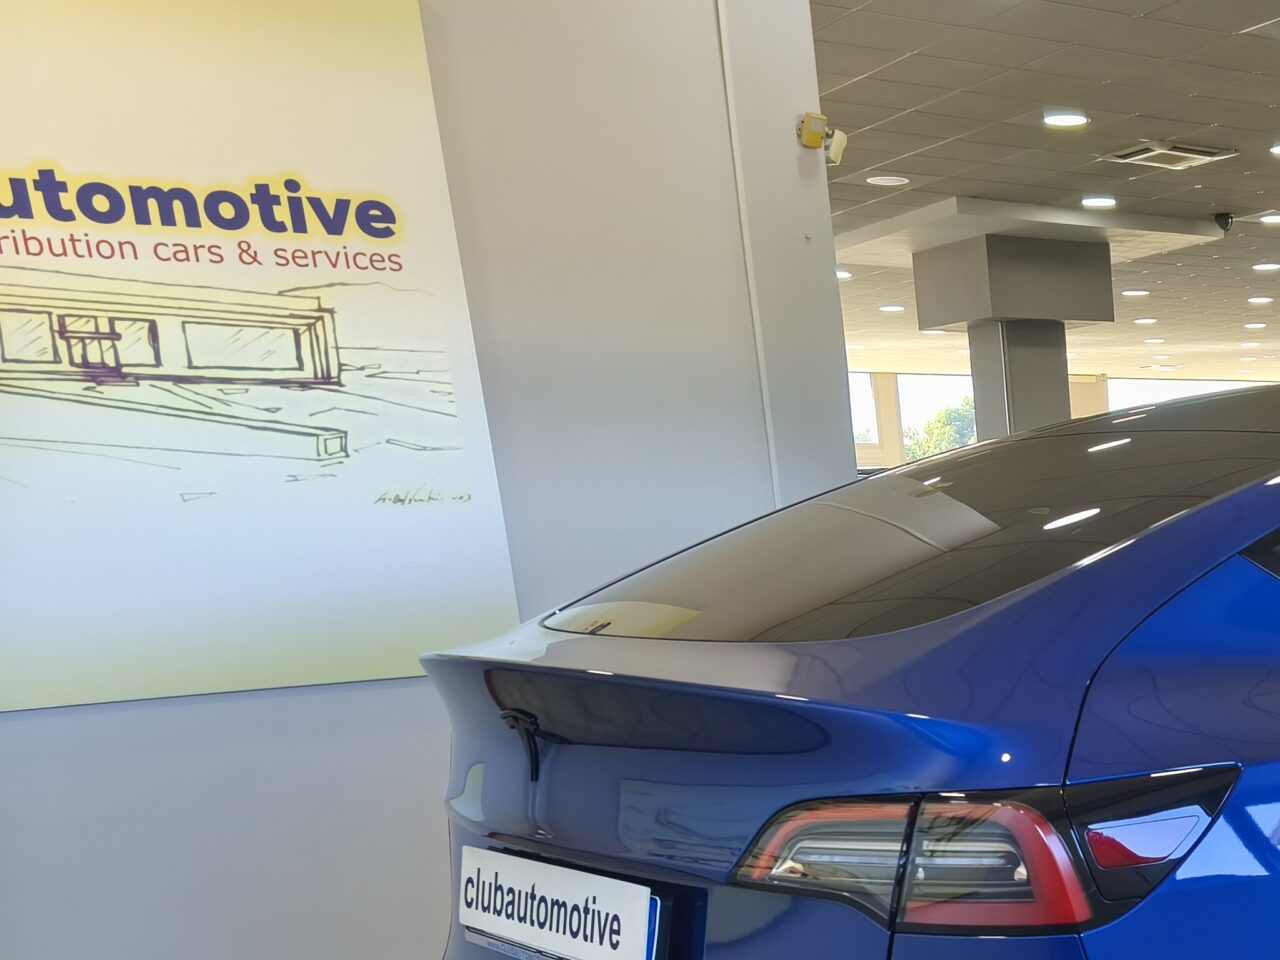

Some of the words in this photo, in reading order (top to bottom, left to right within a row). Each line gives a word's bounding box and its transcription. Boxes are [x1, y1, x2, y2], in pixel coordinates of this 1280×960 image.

[153, 238, 225, 264] cars
[238, 240, 263, 266] &
[273, 245, 403, 272] services
[464, 867, 622, 951] clubautomotive
